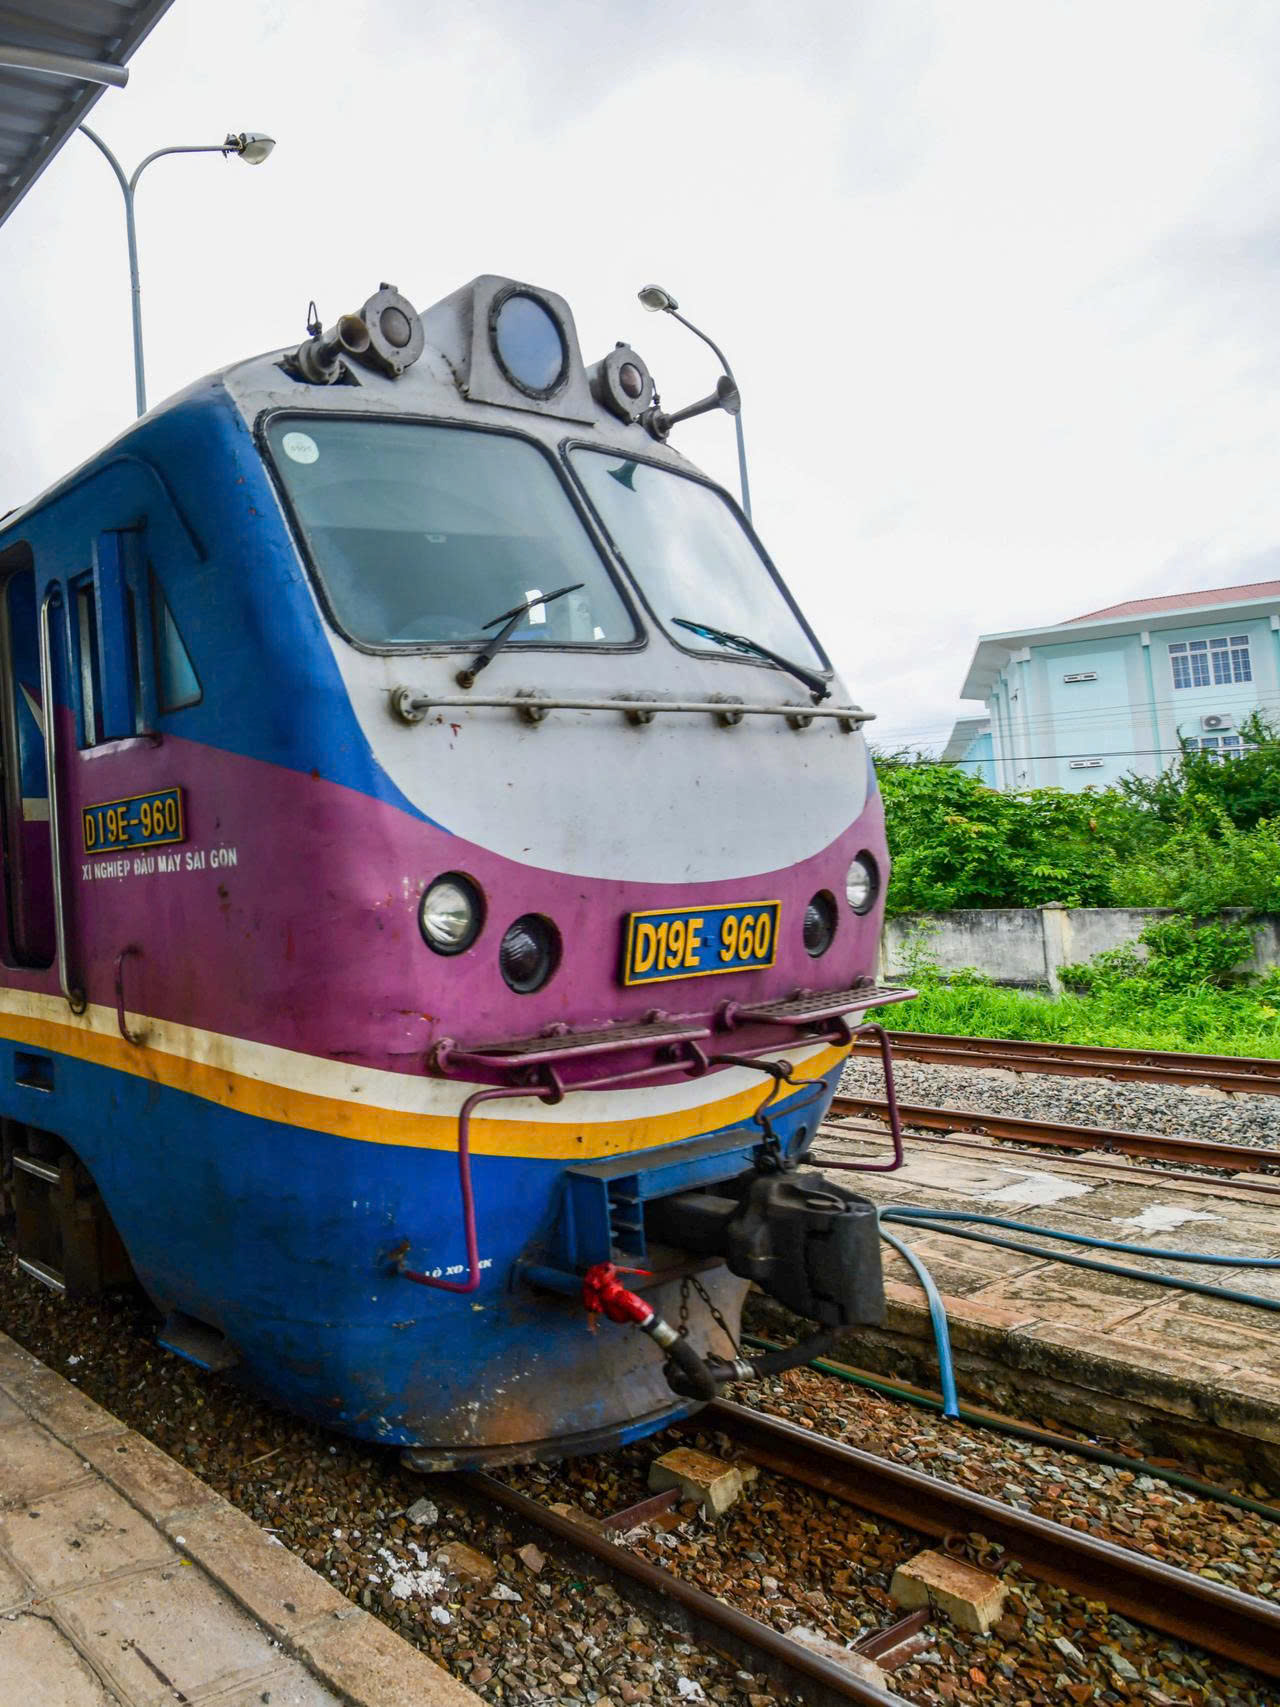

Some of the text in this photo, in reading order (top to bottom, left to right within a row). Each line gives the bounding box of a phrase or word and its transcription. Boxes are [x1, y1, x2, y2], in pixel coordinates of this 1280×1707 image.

[85, 797, 177, 846] D19E-960
[634, 912, 771, 973] D19E 960
